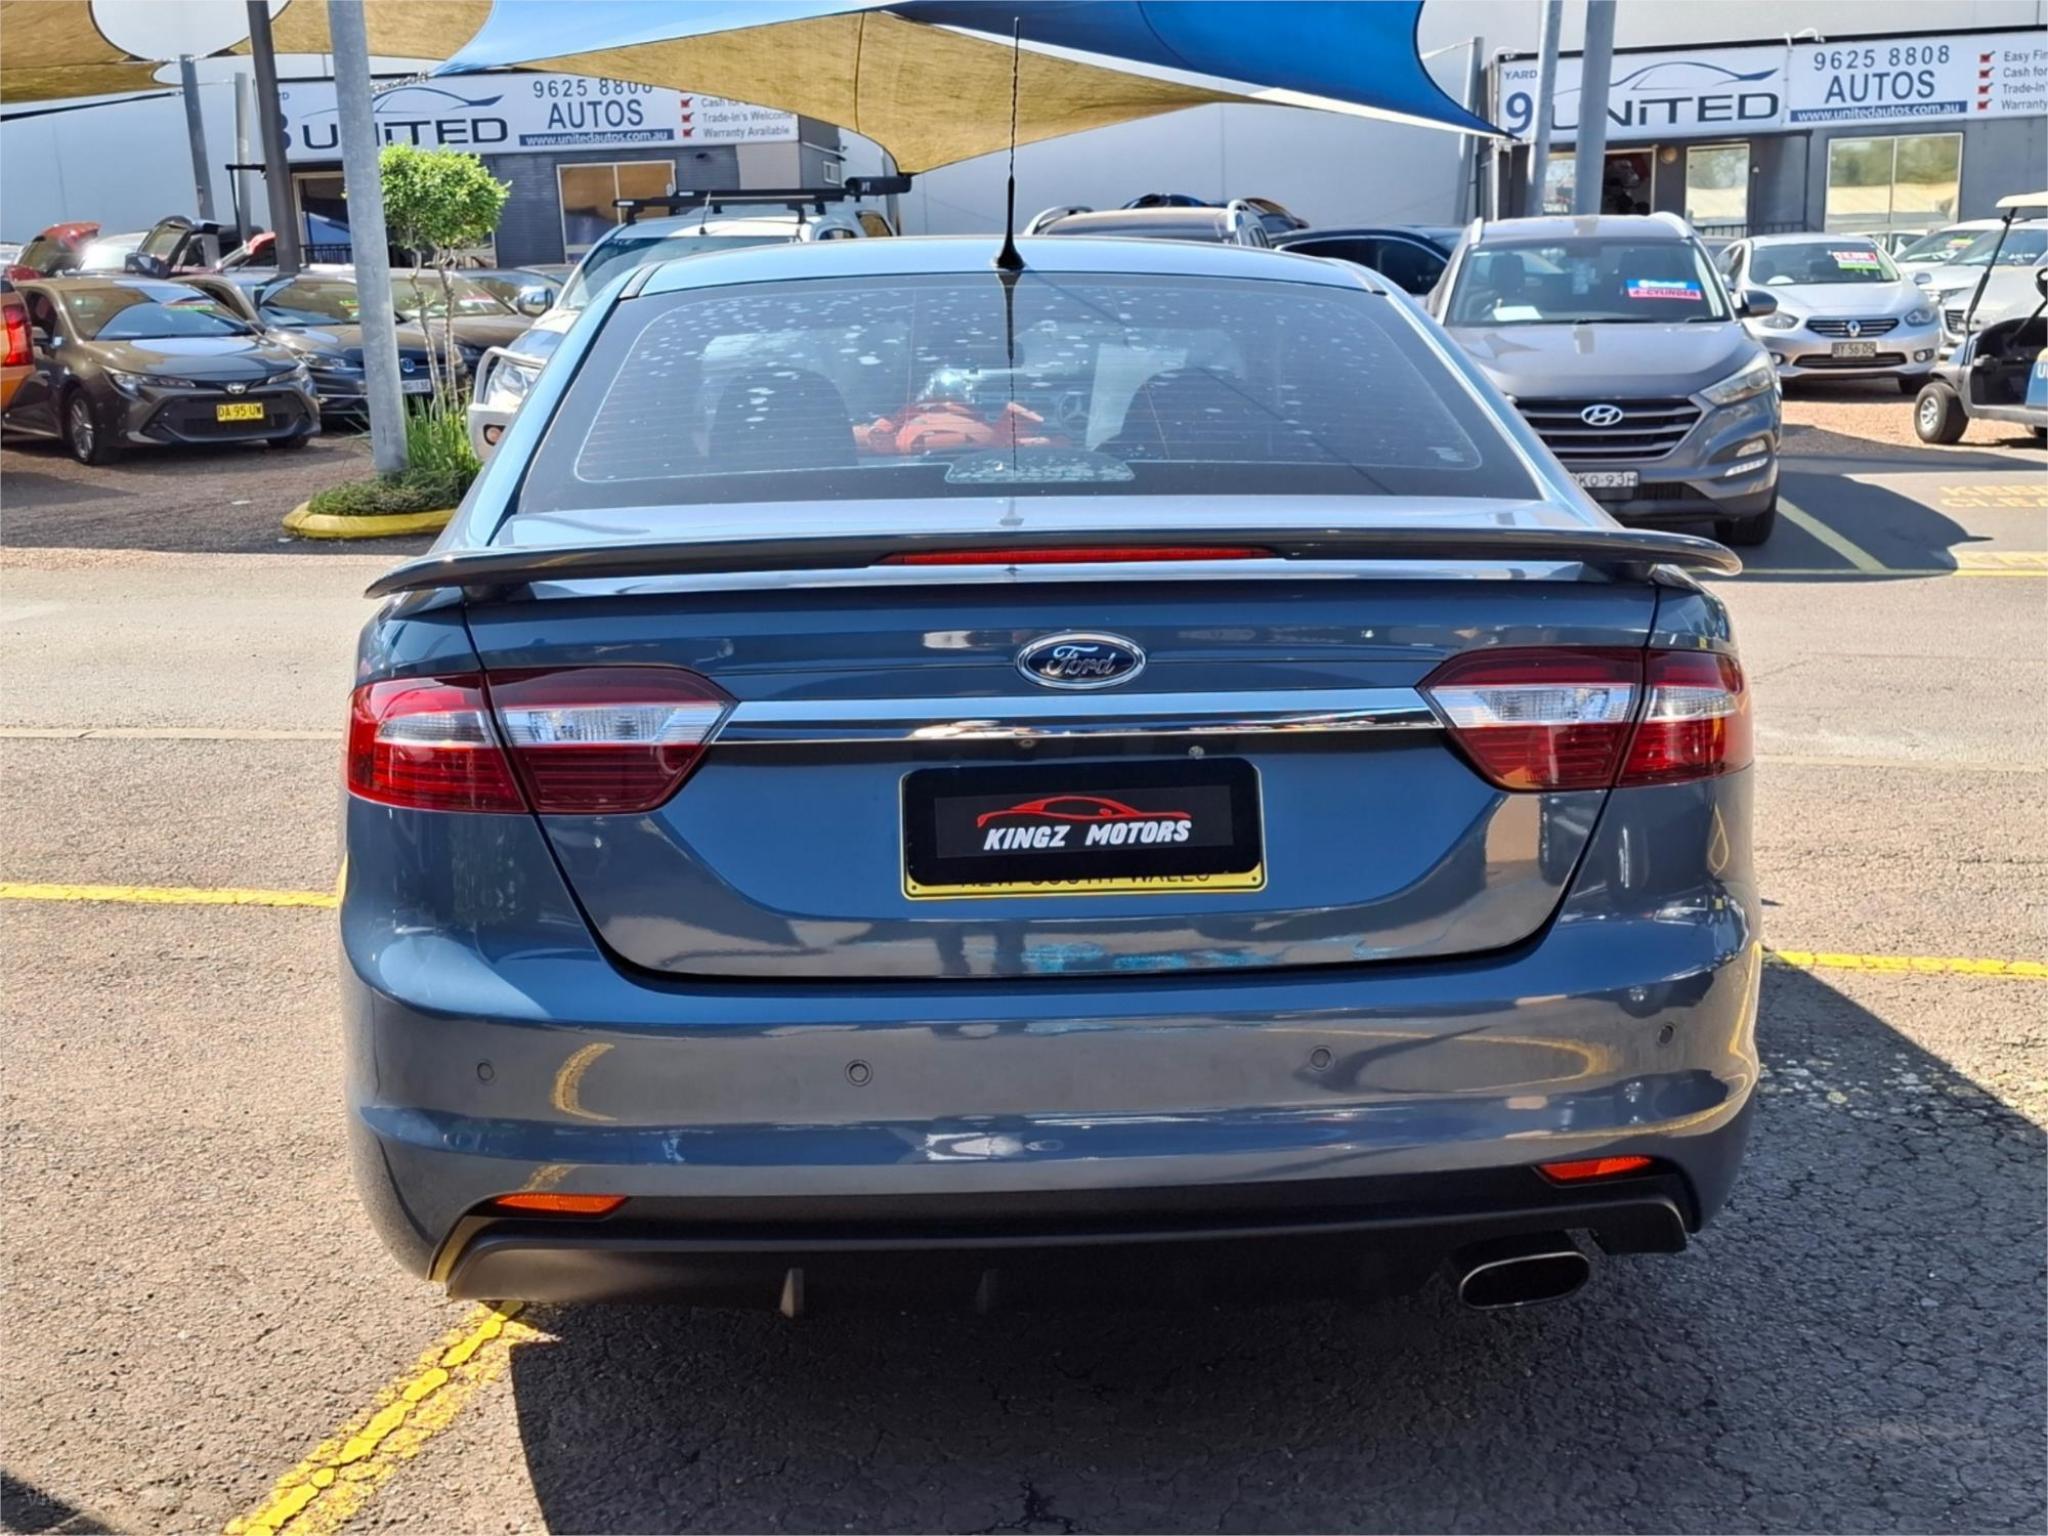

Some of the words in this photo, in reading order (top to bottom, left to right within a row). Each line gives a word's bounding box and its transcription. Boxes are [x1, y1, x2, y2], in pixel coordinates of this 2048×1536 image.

[1813, 49, 1876, 71] 9625
[1888, 45, 1951, 67] 8808
[2004, 50, 2031, 63] Easy
[1504, 69, 1538, 80] YARD
[2003, 67, 2031, 78] Cash
[533, 79, 588, 99] 9625
[1825, 70, 1936, 105] AUTOS
[547, 99, 644, 129] AUTOS
[1506, 91, 1534, 134] 9
[1797, 104, 1961, 122] www.unitedautos.com.au
[302, 118, 508, 150] UITED
[526, 130, 668, 146] www.unitedautos.com.au
[703, 127, 746, 139] Warranty
[747, 125, 790, 137] Available
[1037, 645, 1116, 676] Ford
[983, 824, 1071, 851] KINGZ
[1085, 820, 1192, 846] MOTORS
